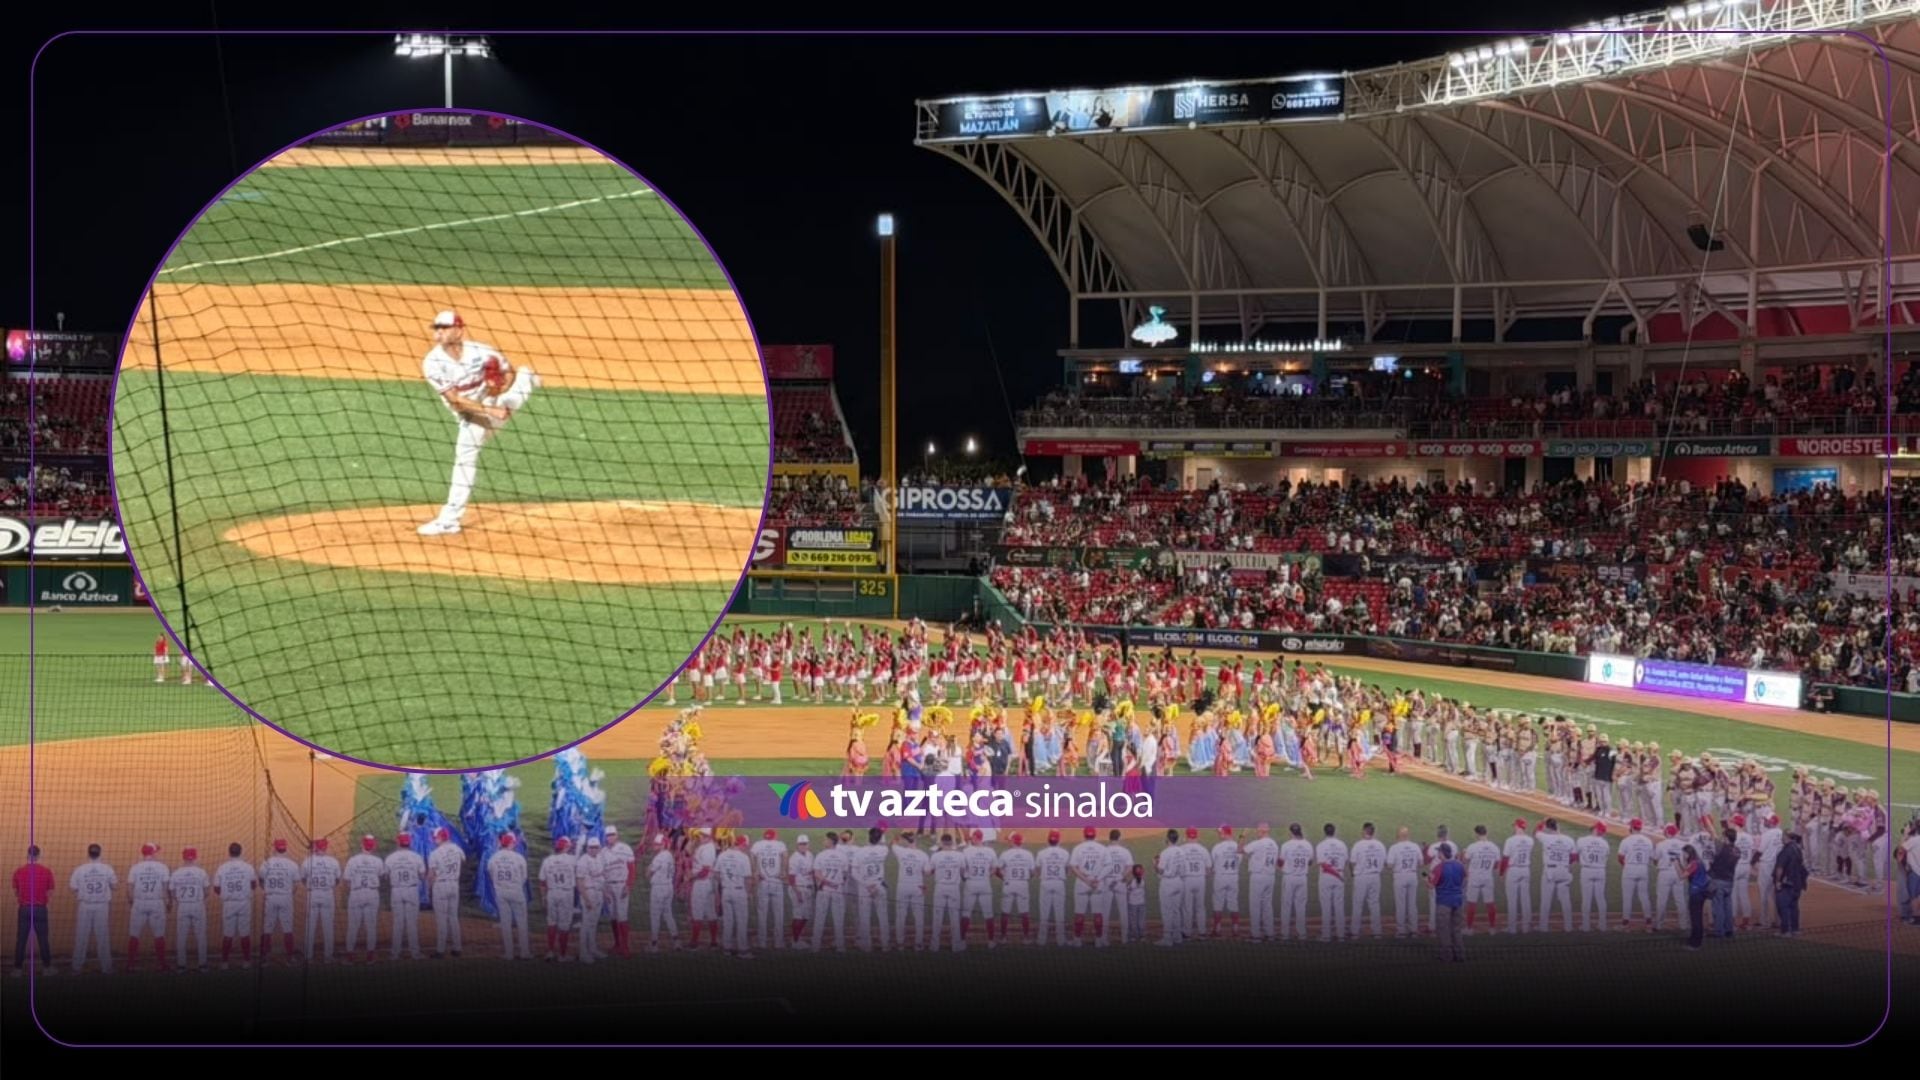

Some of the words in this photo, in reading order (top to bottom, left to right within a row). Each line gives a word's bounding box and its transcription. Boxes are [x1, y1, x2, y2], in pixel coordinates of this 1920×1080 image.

[1197, 94, 1249, 108] HERSA
[412, 113, 472, 127] Banamex
[1692, 444, 1722, 455] Banco
[1723, 444, 1758, 455] Azteca
[1796, 439, 1882, 455] NOROESTE
[811, 553, 829, 562] 669
[859, 579, 886, 596] 325
[41, 591, 77, 601] Banco
[78, 591, 119, 602] Azteca
[1084, 860, 1097, 872] 47
[1223, 860, 1237, 871] 44
[1293, 857, 1306, 869] 99
[972, 866, 986, 877] 33
[143, 881, 157, 893] 37
[180, 886, 196, 899] 73
